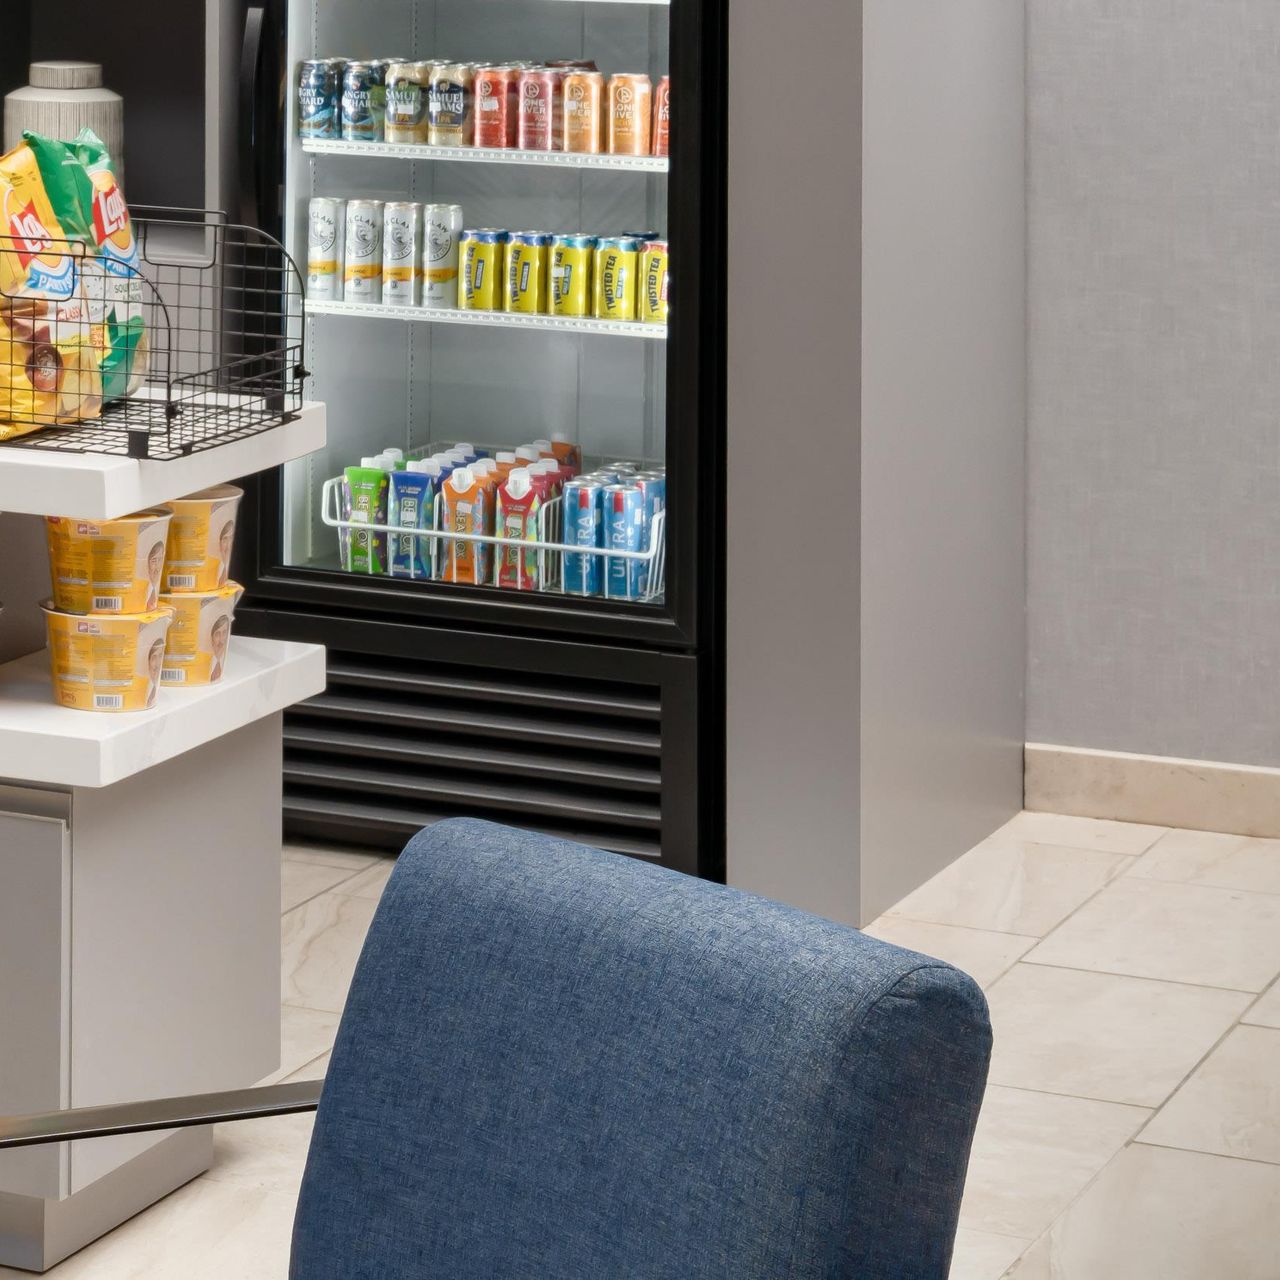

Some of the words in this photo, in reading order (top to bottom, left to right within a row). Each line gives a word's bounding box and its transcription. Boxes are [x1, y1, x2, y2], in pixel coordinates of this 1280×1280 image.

[299, 88, 317, 97] NGRY
[428, 91, 463, 103] SAMUEL
[512, 248, 522, 263] TEA
[607, 255, 617, 271] TEA
[650, 257, 661, 272] TEA
[509, 266, 520, 303] TWISTED
[604, 273, 617, 311] TWISTED
[646, 273, 659, 313] TWISTED
